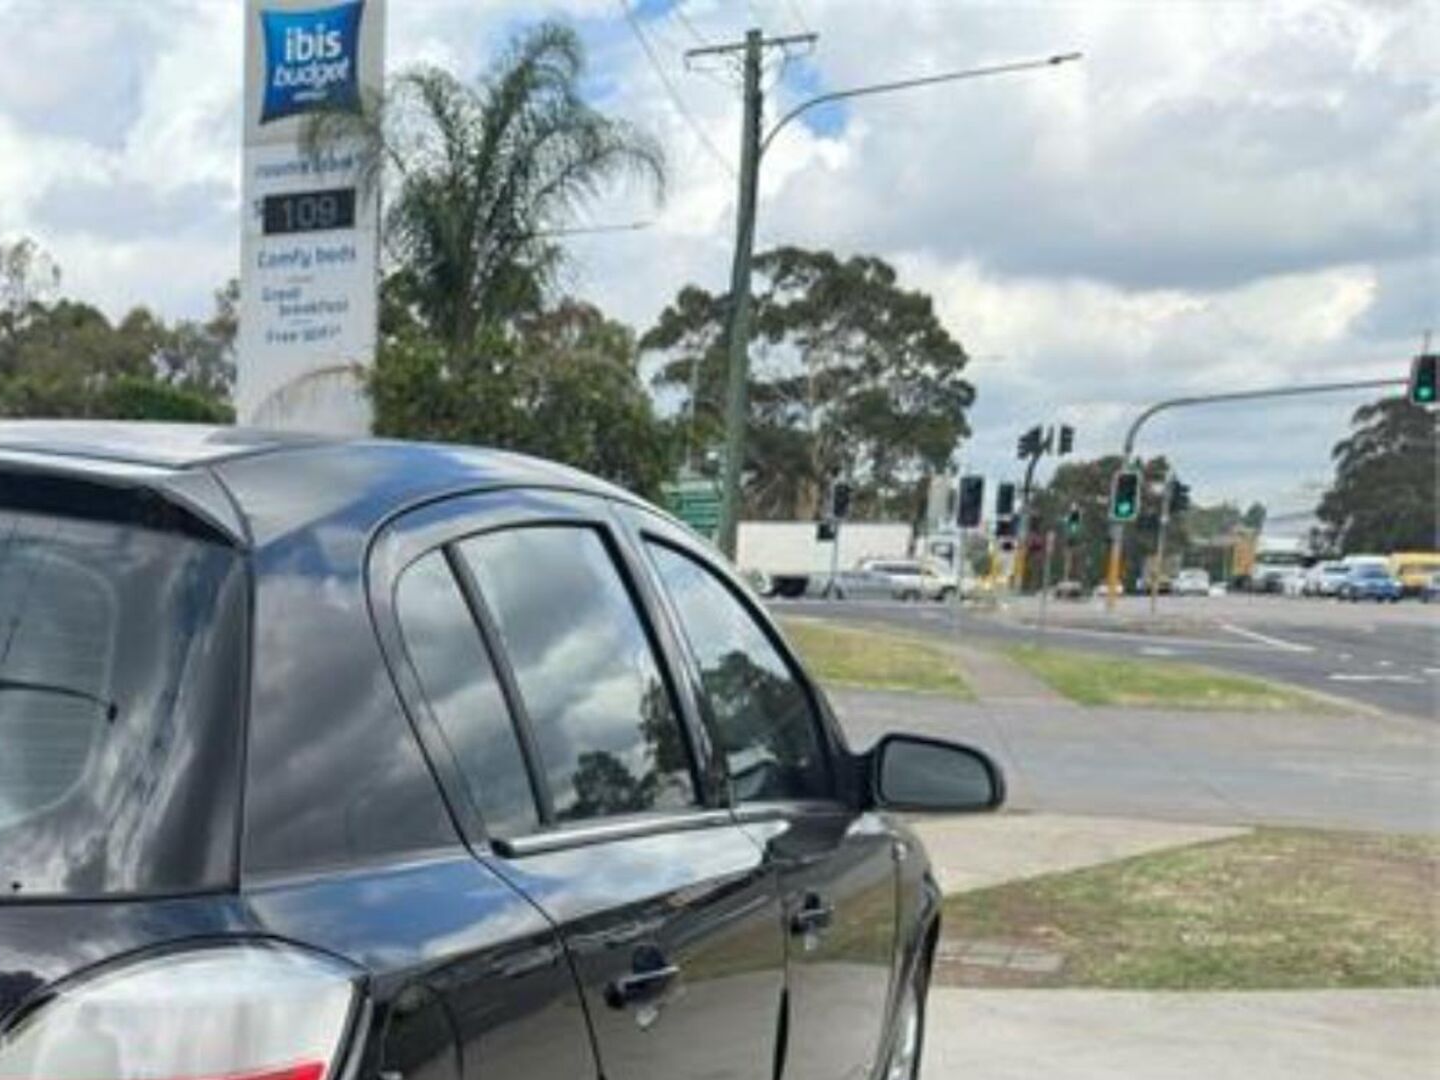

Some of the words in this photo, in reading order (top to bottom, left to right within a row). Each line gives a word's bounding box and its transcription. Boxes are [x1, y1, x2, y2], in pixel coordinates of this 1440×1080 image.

[285, 23, 342, 62] ibis
[273, 57, 349, 88] budget
[287, 197, 340, 229] 109
